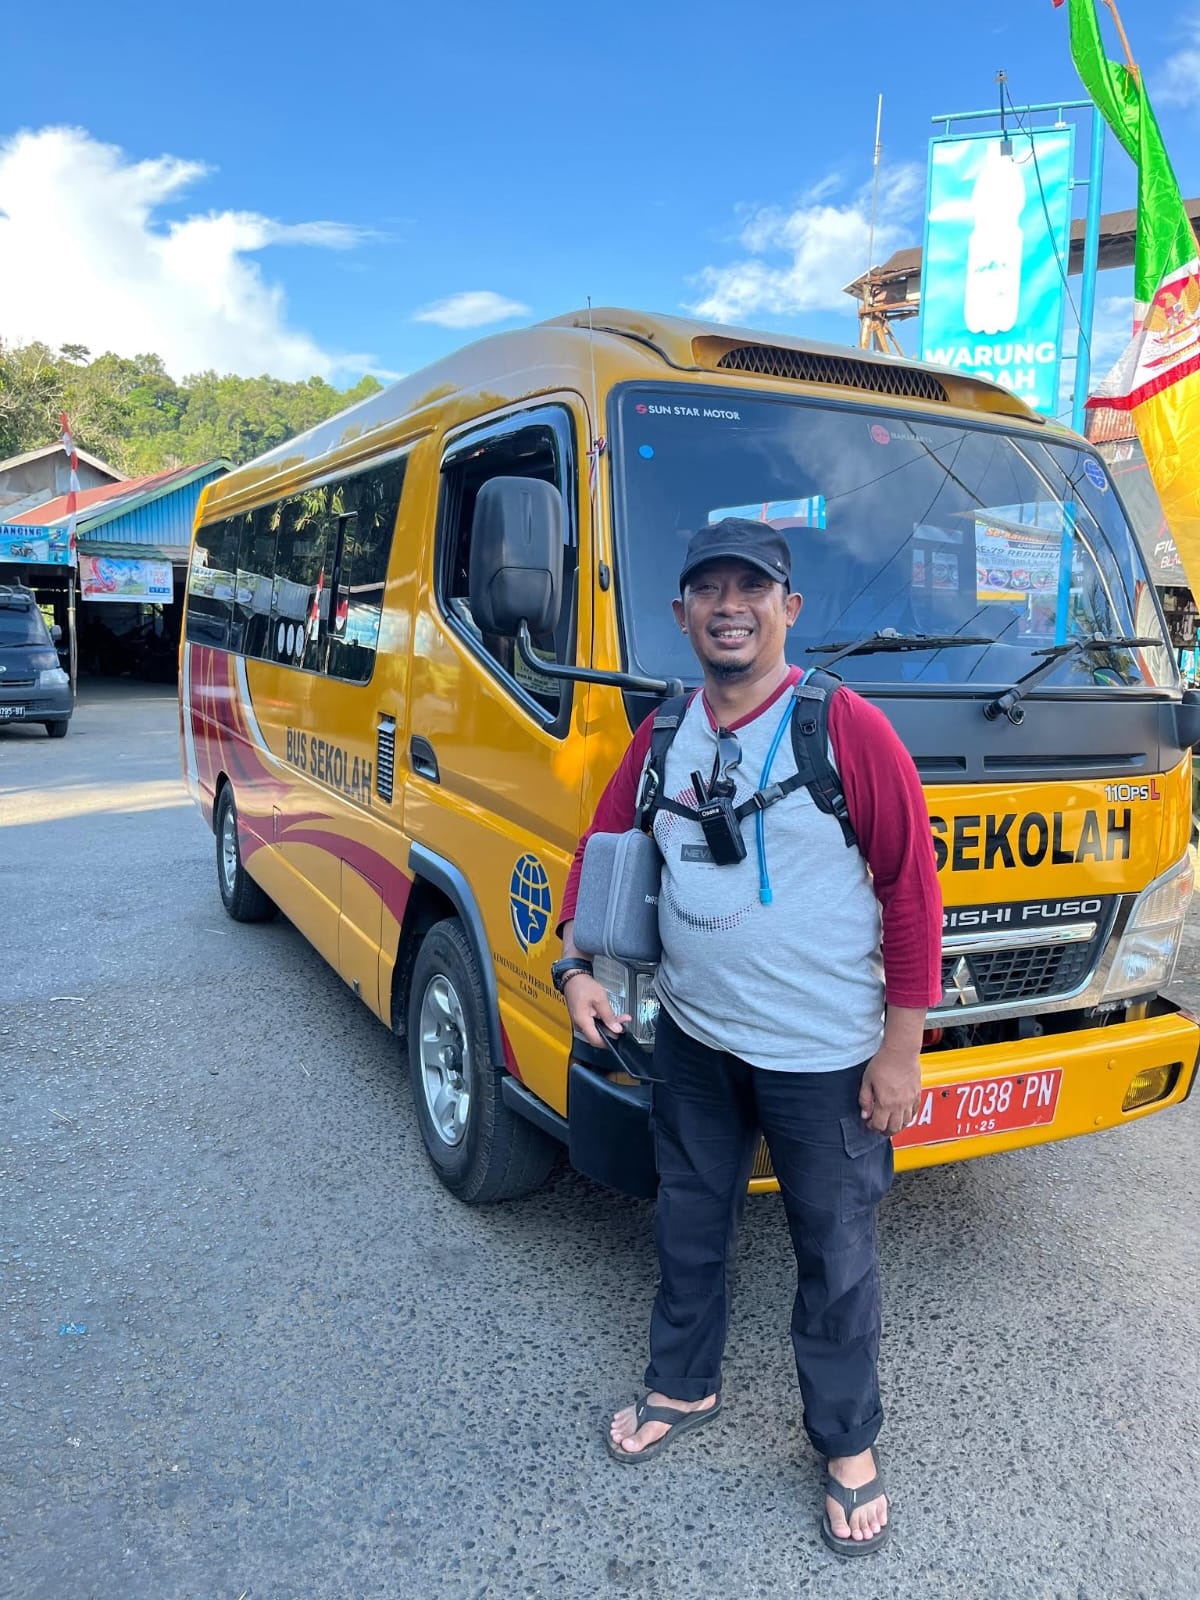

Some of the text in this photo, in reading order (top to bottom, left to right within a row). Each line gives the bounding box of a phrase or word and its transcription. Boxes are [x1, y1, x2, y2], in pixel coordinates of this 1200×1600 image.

[924, 342, 1056, 367] WARUNG
[648, 404, 741, 421] SUN STAR MOTOR
[0, 526, 42, 537] ANCING
[287, 729, 372, 807] BUS SEKOLAH
[929, 807, 1132, 873] SEKOLAH
[1021, 898, 1103, 920] FUSO
[955, 1080, 1013, 1120] 7038
[1021, 1073, 1055, 1109] PN
